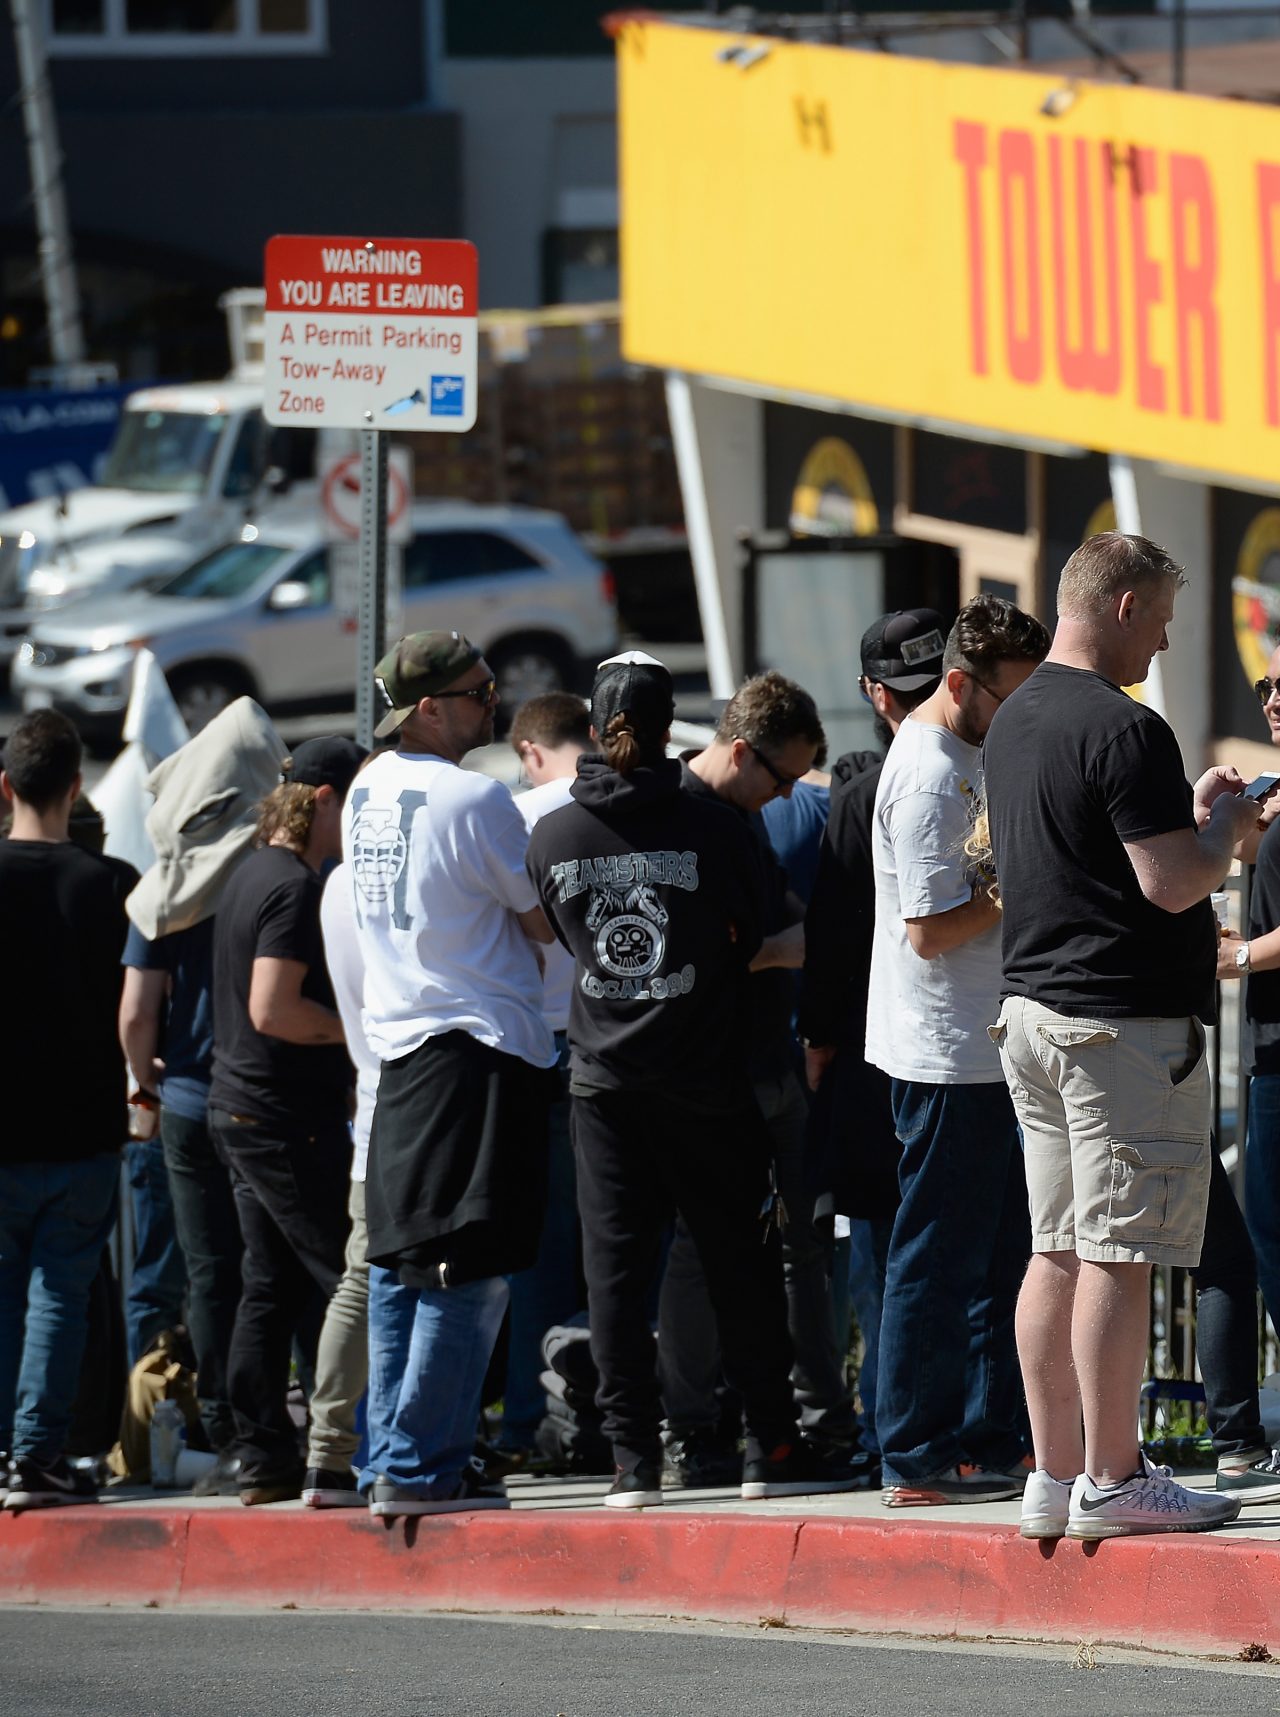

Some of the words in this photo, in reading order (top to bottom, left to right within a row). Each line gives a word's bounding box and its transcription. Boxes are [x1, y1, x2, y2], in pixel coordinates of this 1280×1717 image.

[322, 248, 421, 276] WARNING
[953, 116, 1224, 427] TOWER
[280, 280, 321, 306] YOU
[328, 282, 370, 308] ARE
[376, 283, 464, 310] LEAVING
[280, 323, 295, 345] A
[305, 324, 372, 346] Permit
[383, 325, 462, 355] Parking
[280, 357, 386, 385] Tow-Away
[279, 390, 325, 413] Zone
[551, 851, 699, 903] TEAMSTERS
[606, 917, 649, 930] TEAMSTERS
[582, 966, 649, 999] LOCAL
[651, 964, 696, 999] 399
